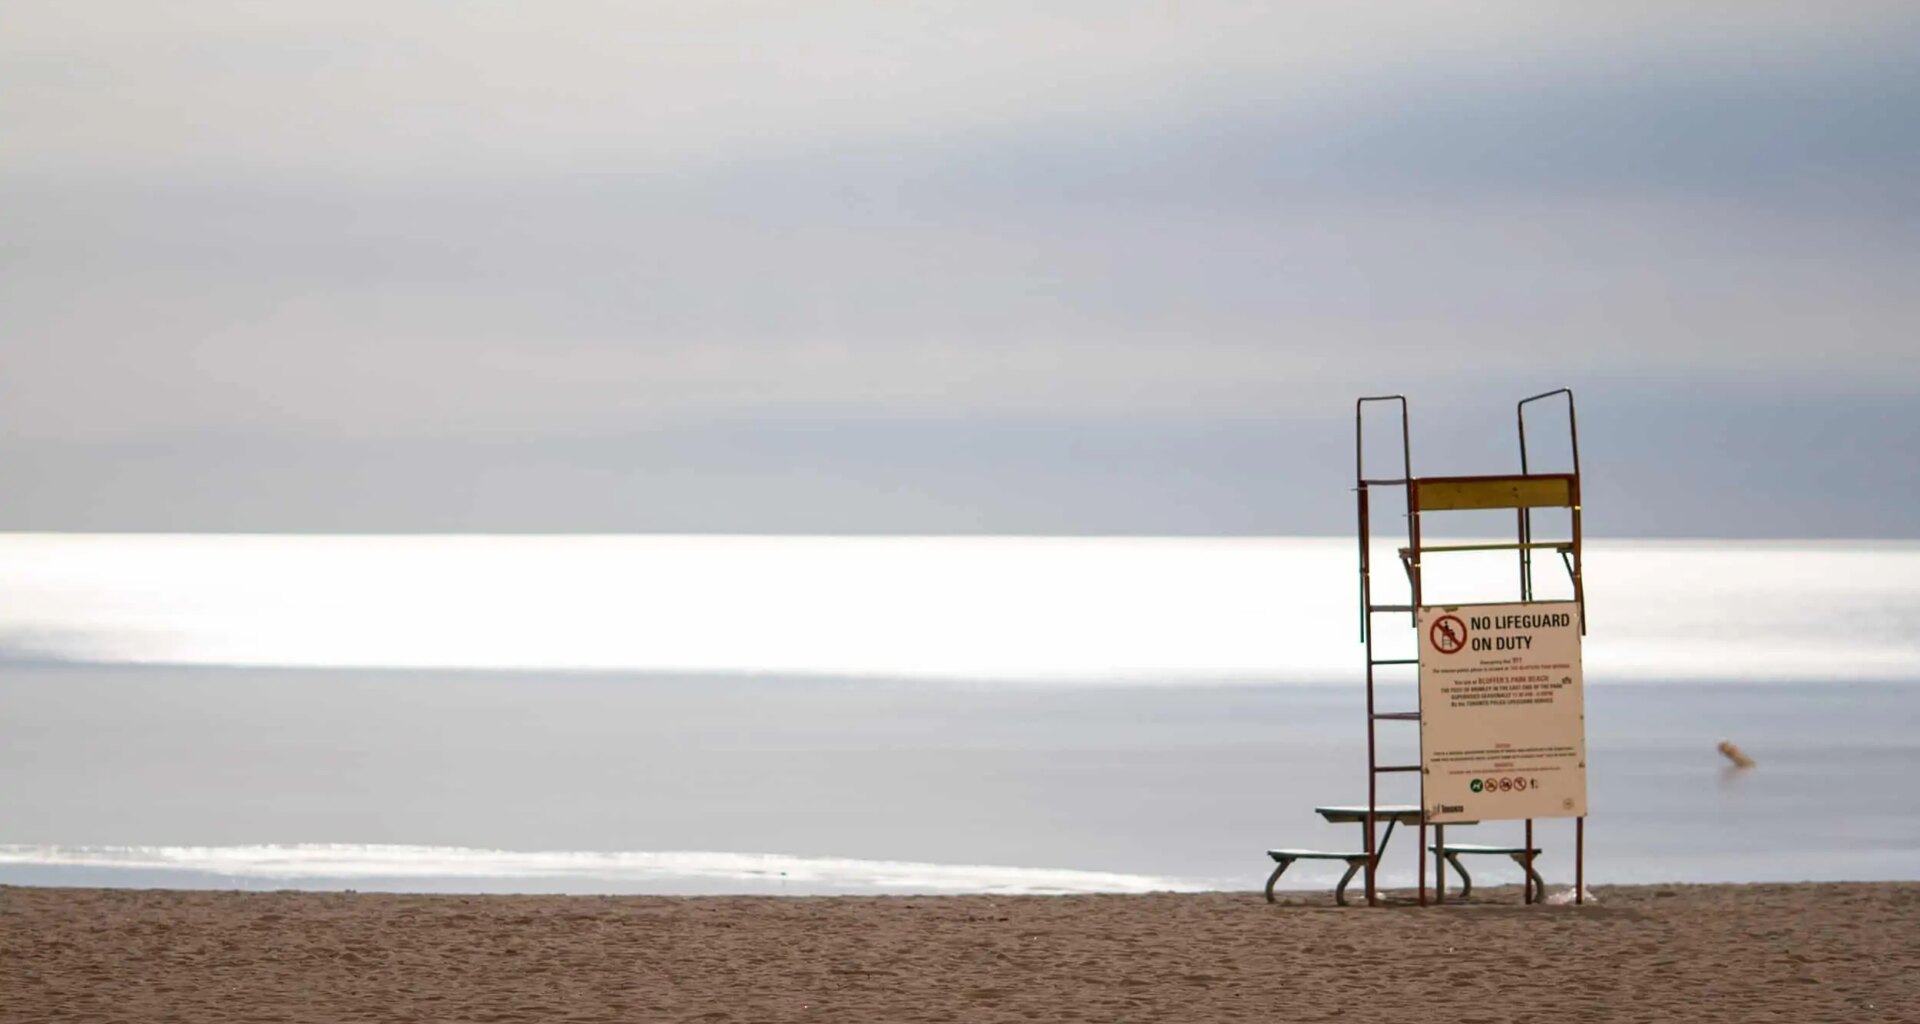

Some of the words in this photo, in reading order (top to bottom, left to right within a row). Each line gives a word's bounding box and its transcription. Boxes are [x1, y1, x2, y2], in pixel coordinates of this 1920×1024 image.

[1471, 616, 1491, 630] NO
[1495, 613, 1570, 630] LIFEGUARD
[1471, 637, 1492, 651] ON
[1496, 635, 1533, 650] DUTY
